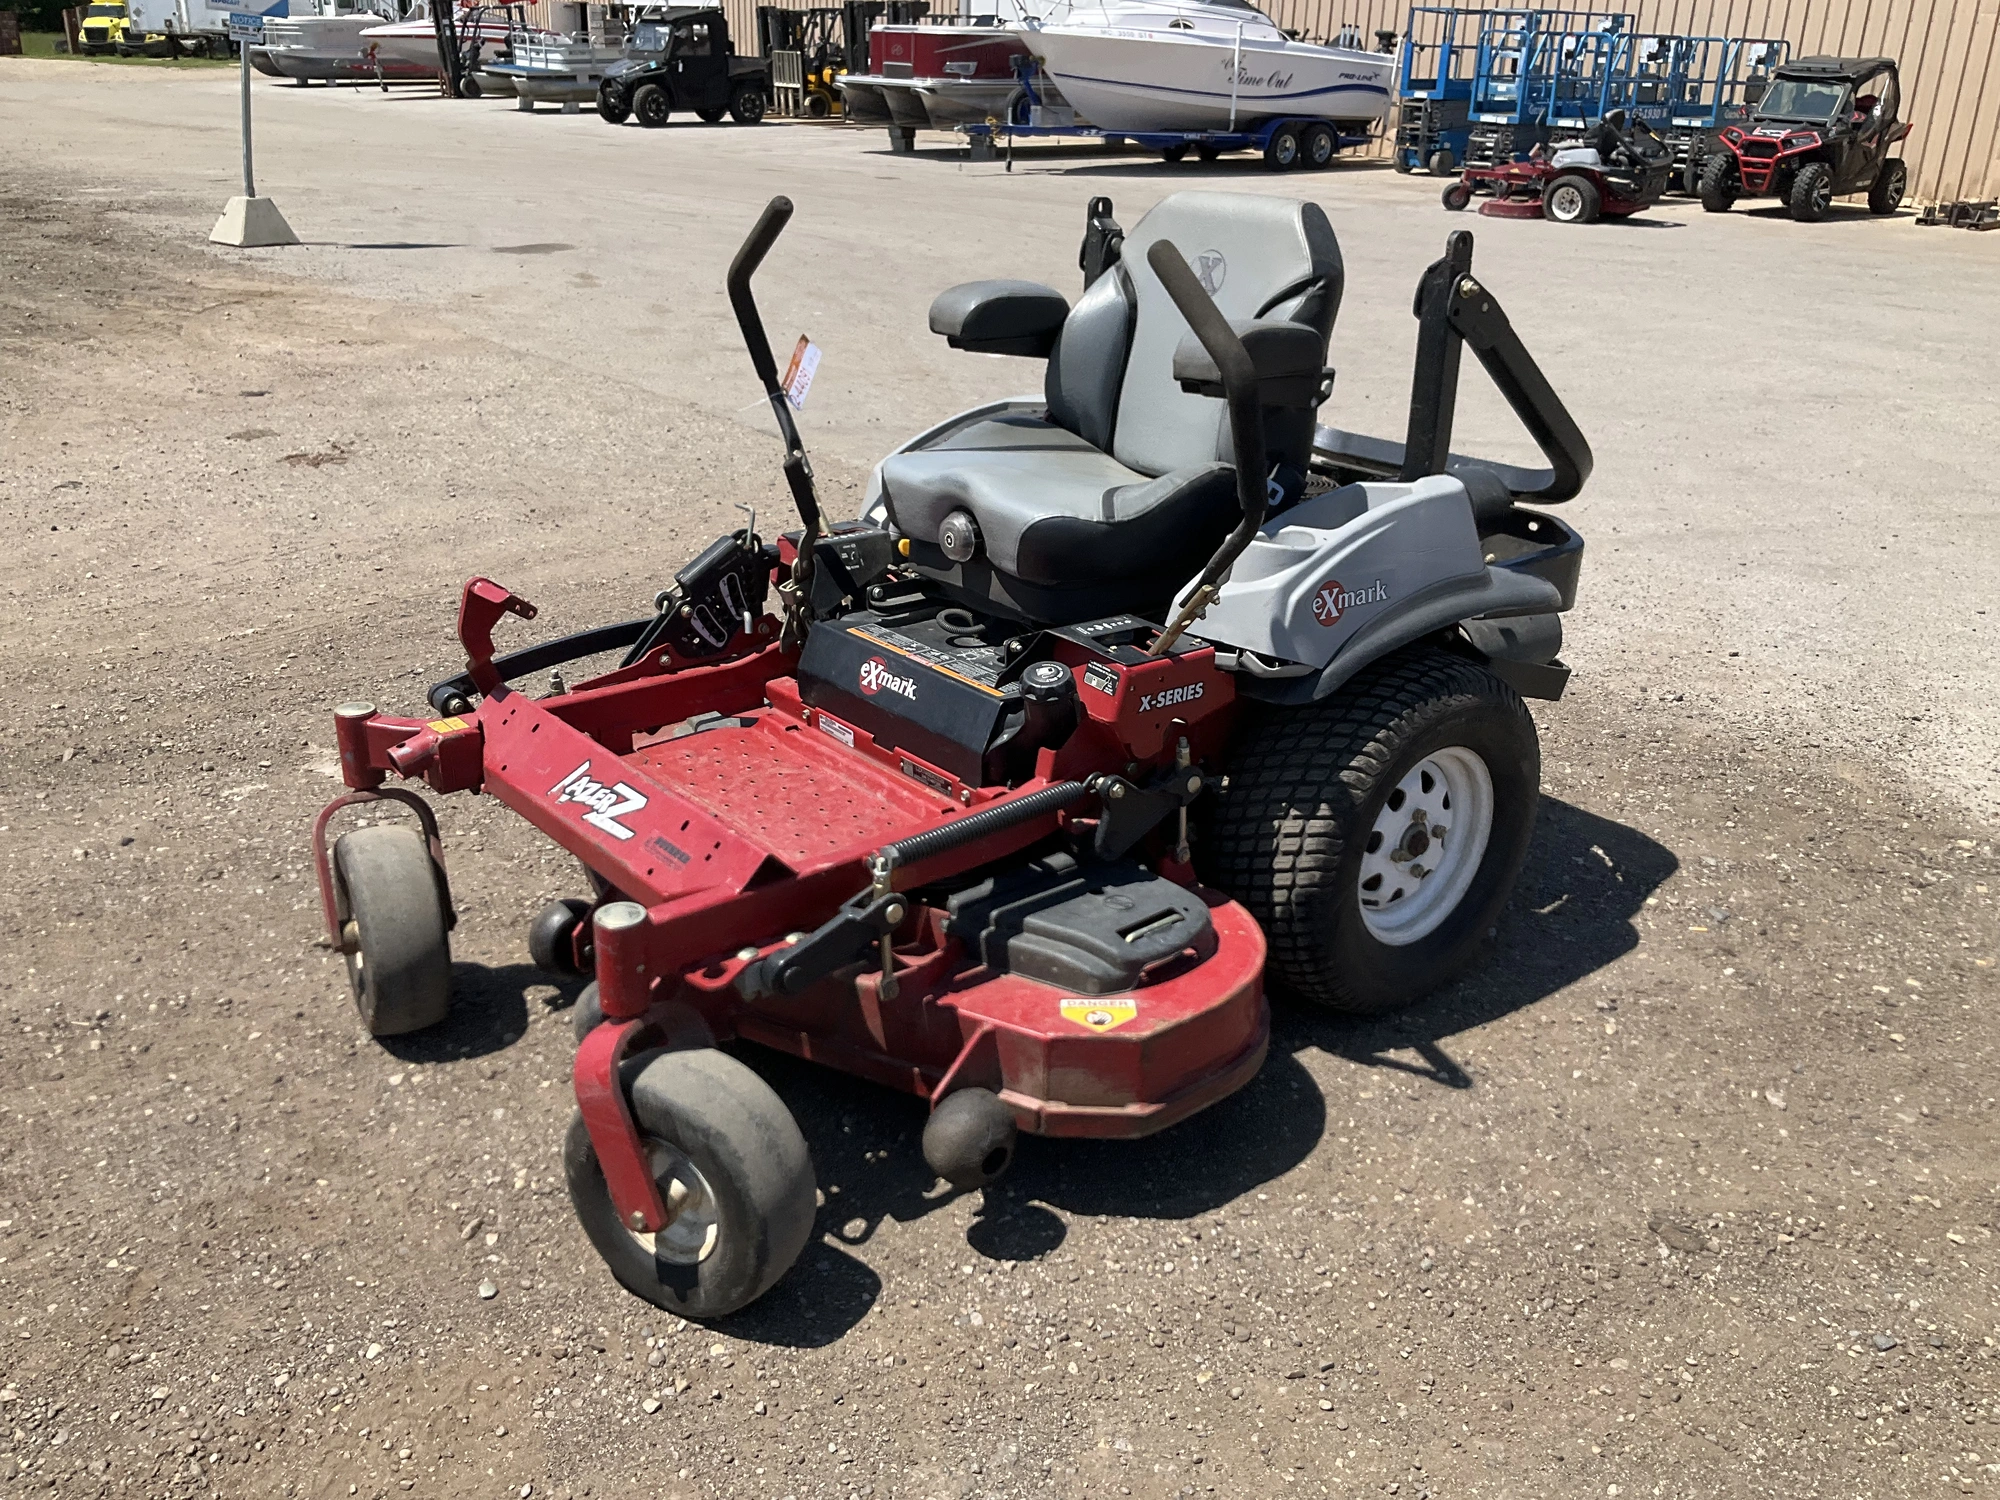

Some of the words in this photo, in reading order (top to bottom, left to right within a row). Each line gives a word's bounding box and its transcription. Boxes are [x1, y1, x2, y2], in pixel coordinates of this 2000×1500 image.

[231, 15, 262, 26] NOTICE
[1267, 70, 1293, 88] Out
[1338, 72, 1373, 82] PRO-LINE
[1312, 580, 1388, 620] eXmark
[860, 660, 918, 700] eXmark
[1138, 682, 1204, 712] X-SERIES
